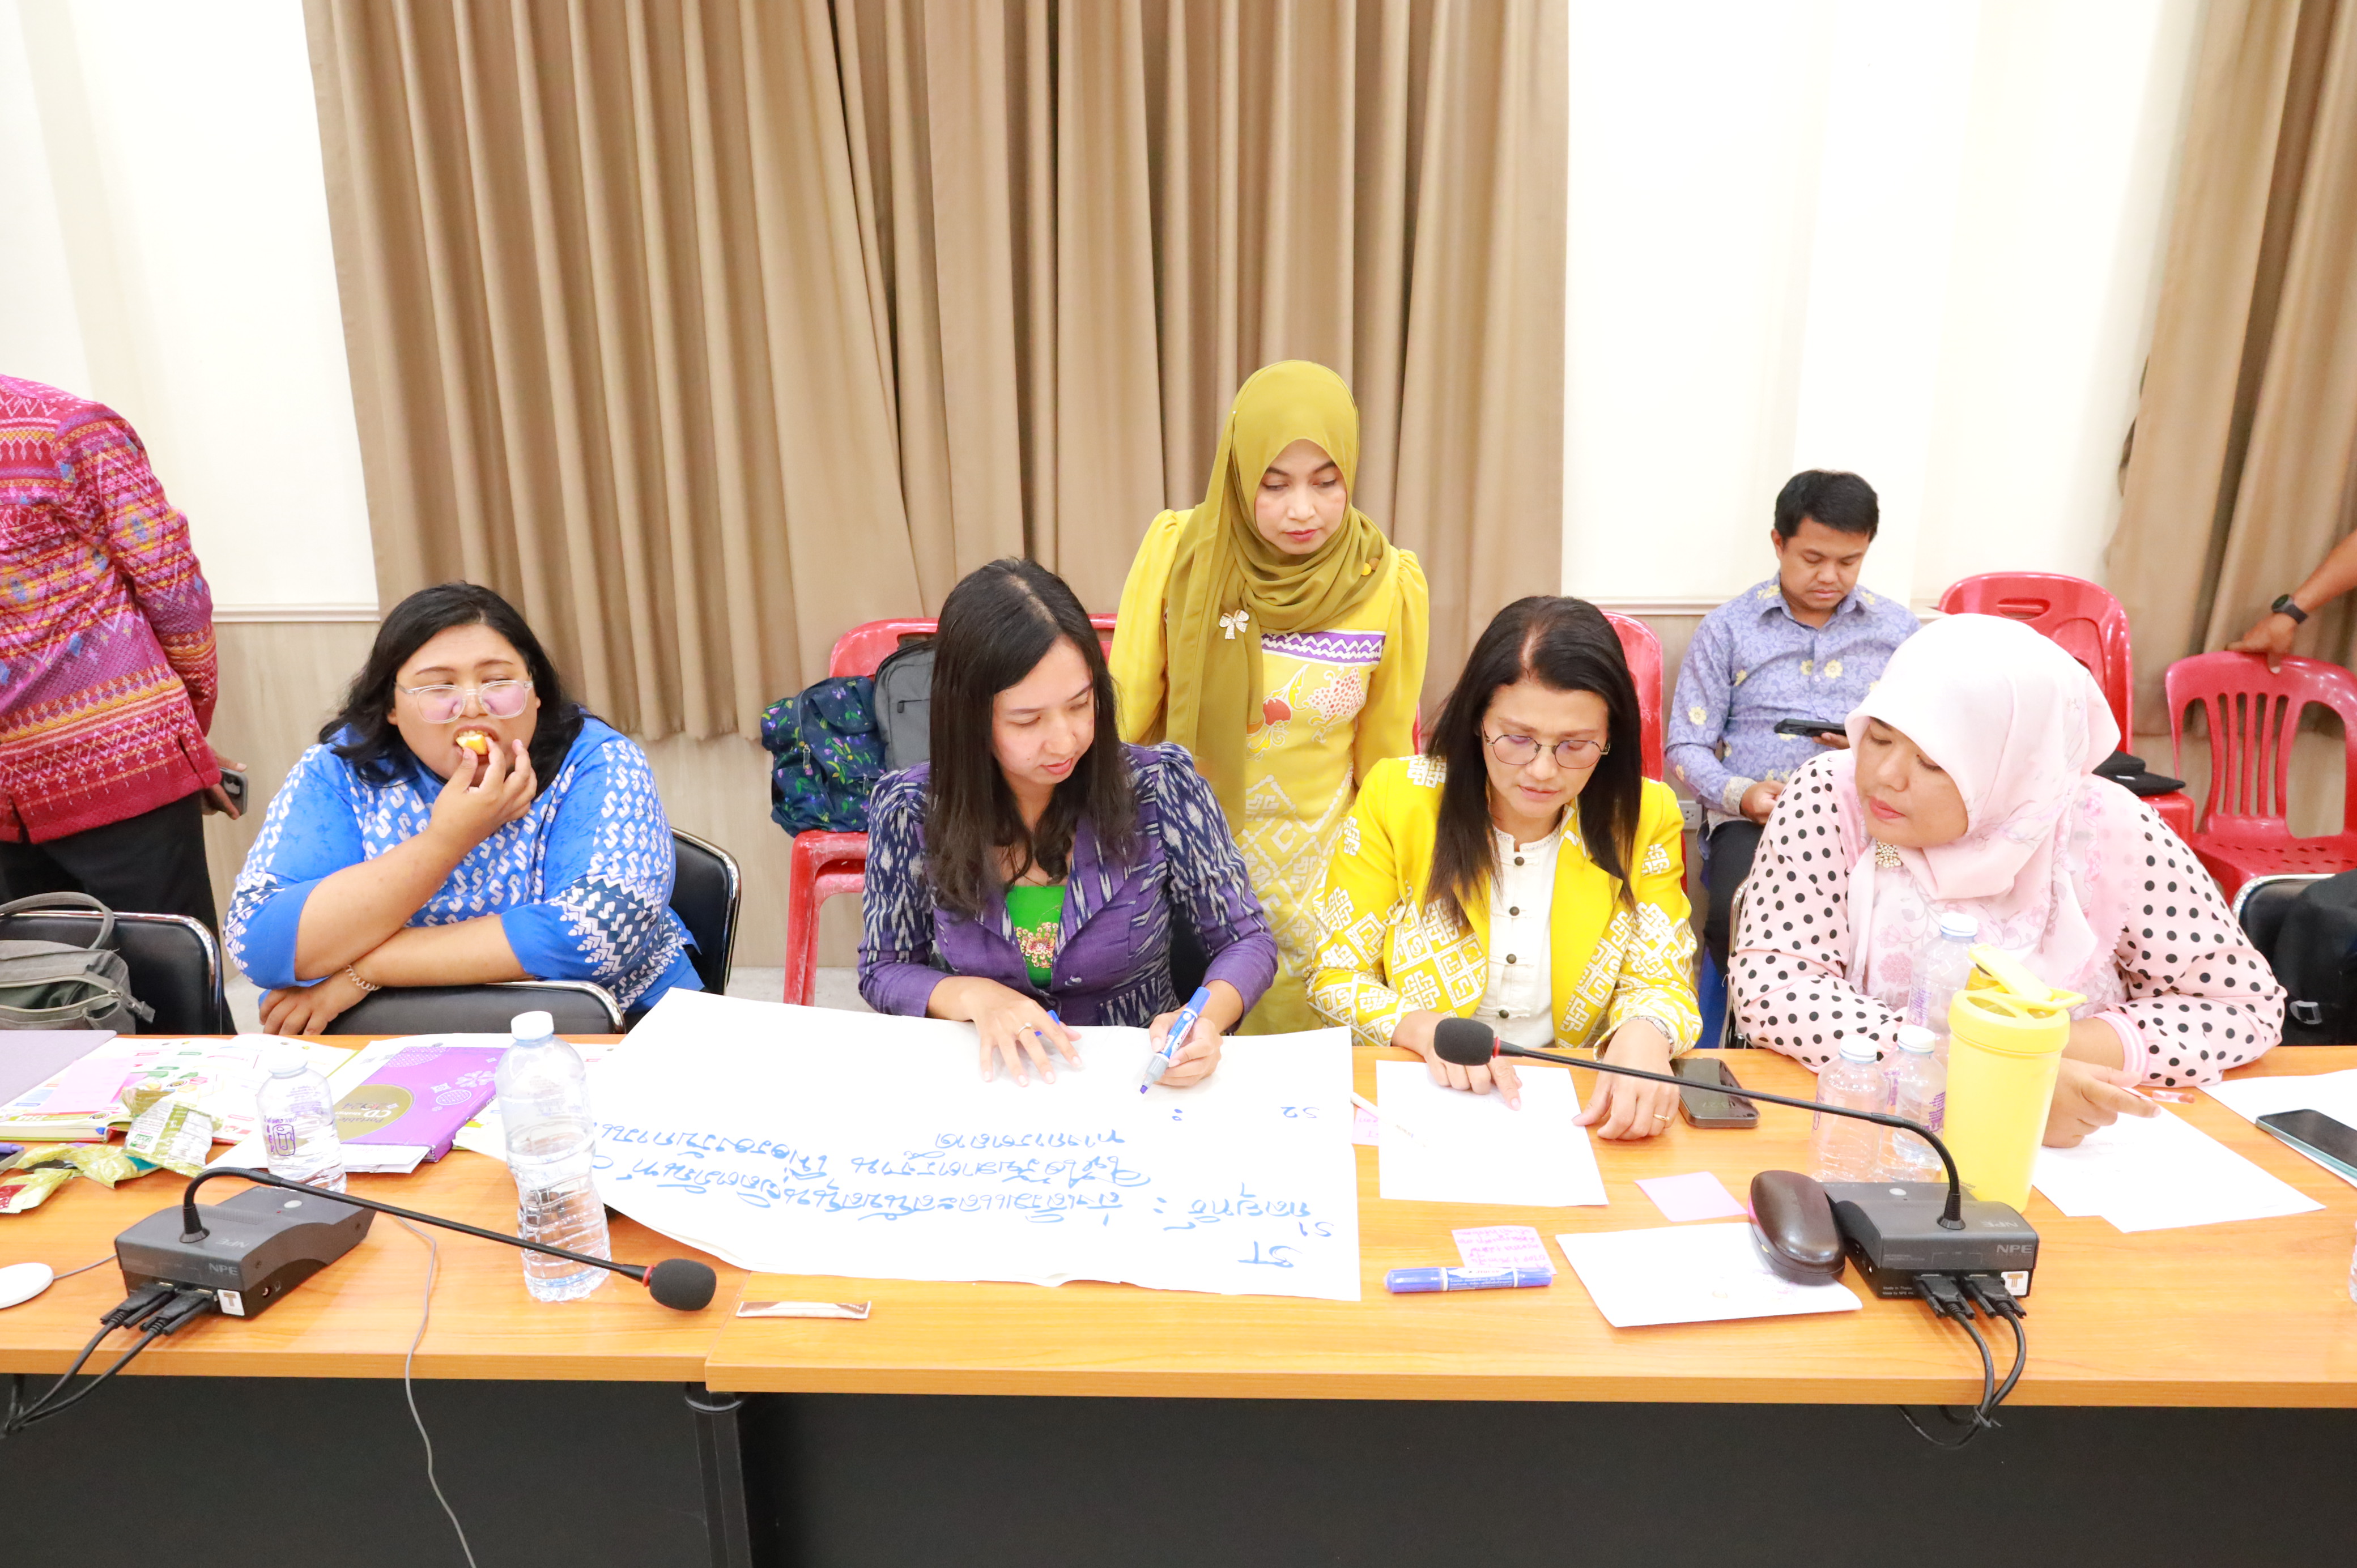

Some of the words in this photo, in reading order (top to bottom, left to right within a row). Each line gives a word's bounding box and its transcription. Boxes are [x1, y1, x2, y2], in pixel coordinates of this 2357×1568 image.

[1280, 1106, 1320, 1119] S2
[215, 1238, 250, 1249] NPE
[1997, 1245, 2032, 1254] NPE
[209, 1263, 239, 1276] NPE
